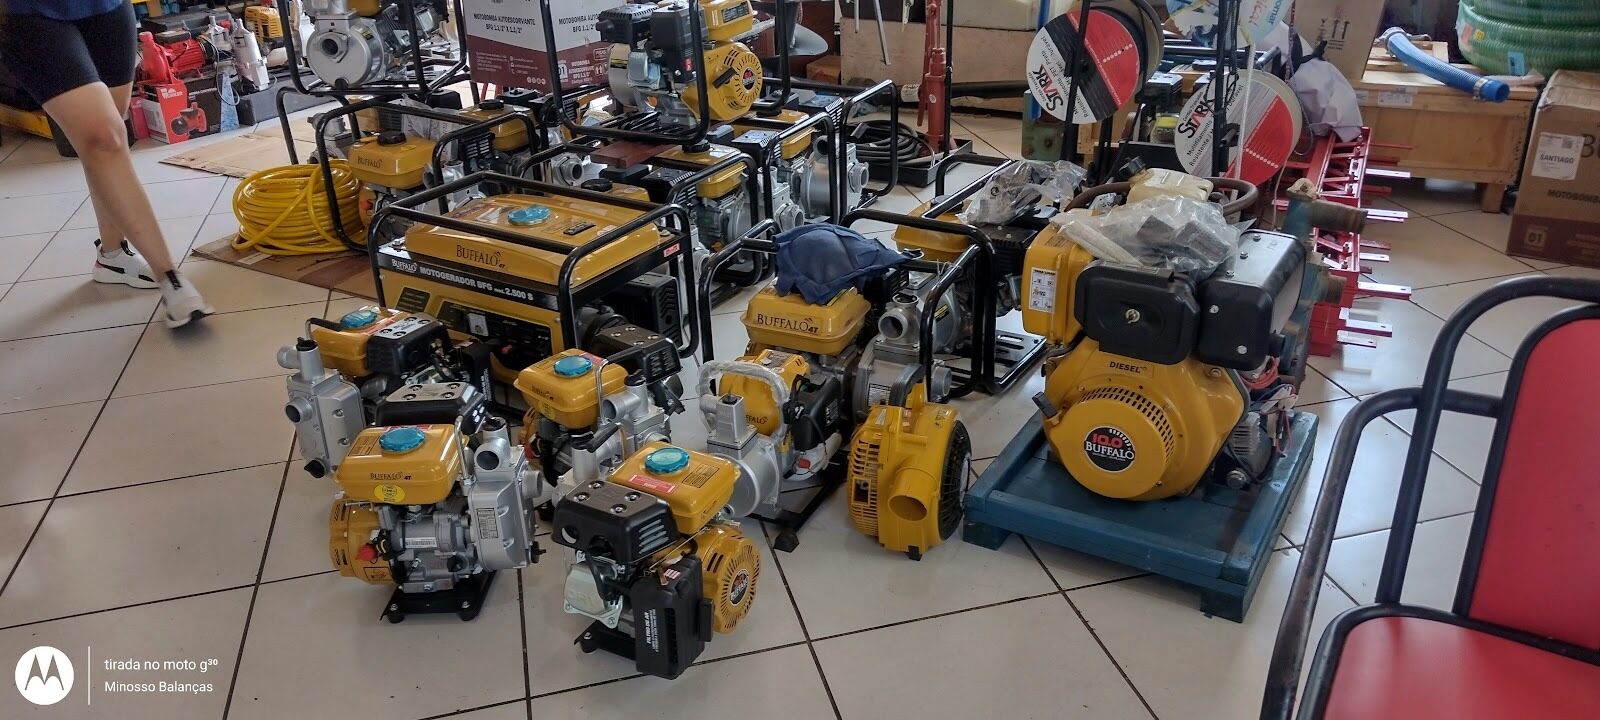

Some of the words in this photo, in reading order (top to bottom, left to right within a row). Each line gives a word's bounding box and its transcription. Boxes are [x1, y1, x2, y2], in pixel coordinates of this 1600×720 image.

[558, 15, 586, 24] MOTOBOMBA
[1032, 64, 1063, 111] STARK
[1540, 153, 1575, 164] SANTIAGO
[456, 245, 500, 267] BUFFALO
[392, 258, 418, 272] BUFFALO
[420, 266, 476, 287] MOTOGERADOR
[476, 280, 492, 290] BFG
[504, 288, 526, 299] 2.500
[757, 313, 809, 331] BUFFALO
[1109, 361, 1141, 374] DIESEL
[1092, 433, 1123, 448] 10.0
[1085, 440, 1135, 460] BUFFALO
[370, 472, 402, 480] BUFFALO
